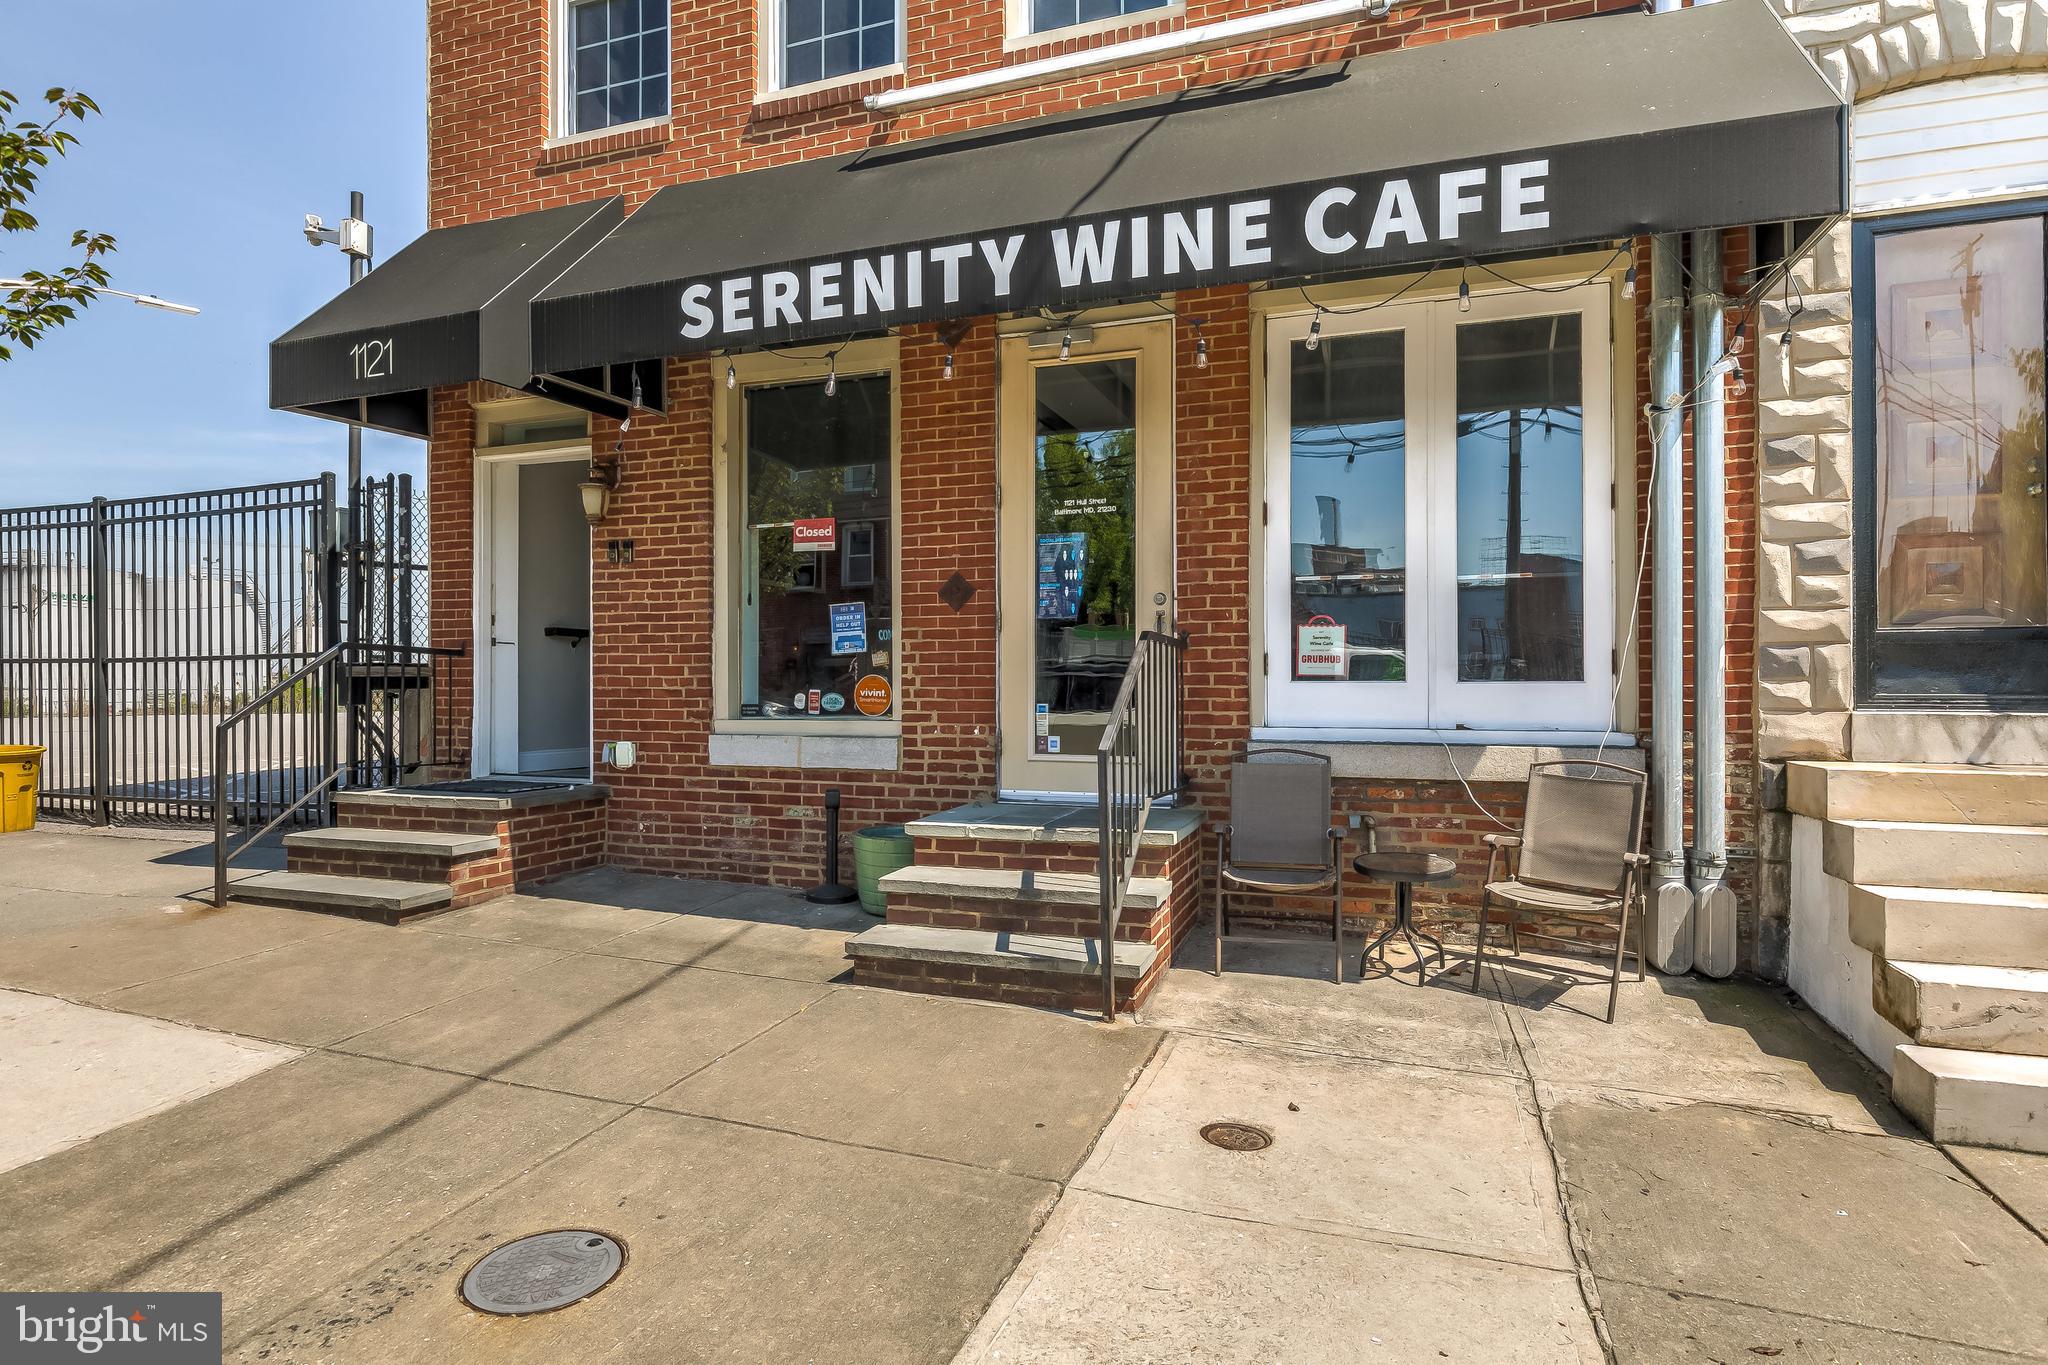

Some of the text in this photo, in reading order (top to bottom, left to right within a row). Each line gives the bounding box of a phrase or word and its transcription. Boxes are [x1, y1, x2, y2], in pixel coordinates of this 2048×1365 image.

[680, 159, 1550, 339] SERENITY WINE CAFE
[350, 338, 393, 380] 1121
[796, 526, 832, 537] Closed
[1302, 655, 1341, 663] GRUBHUB
